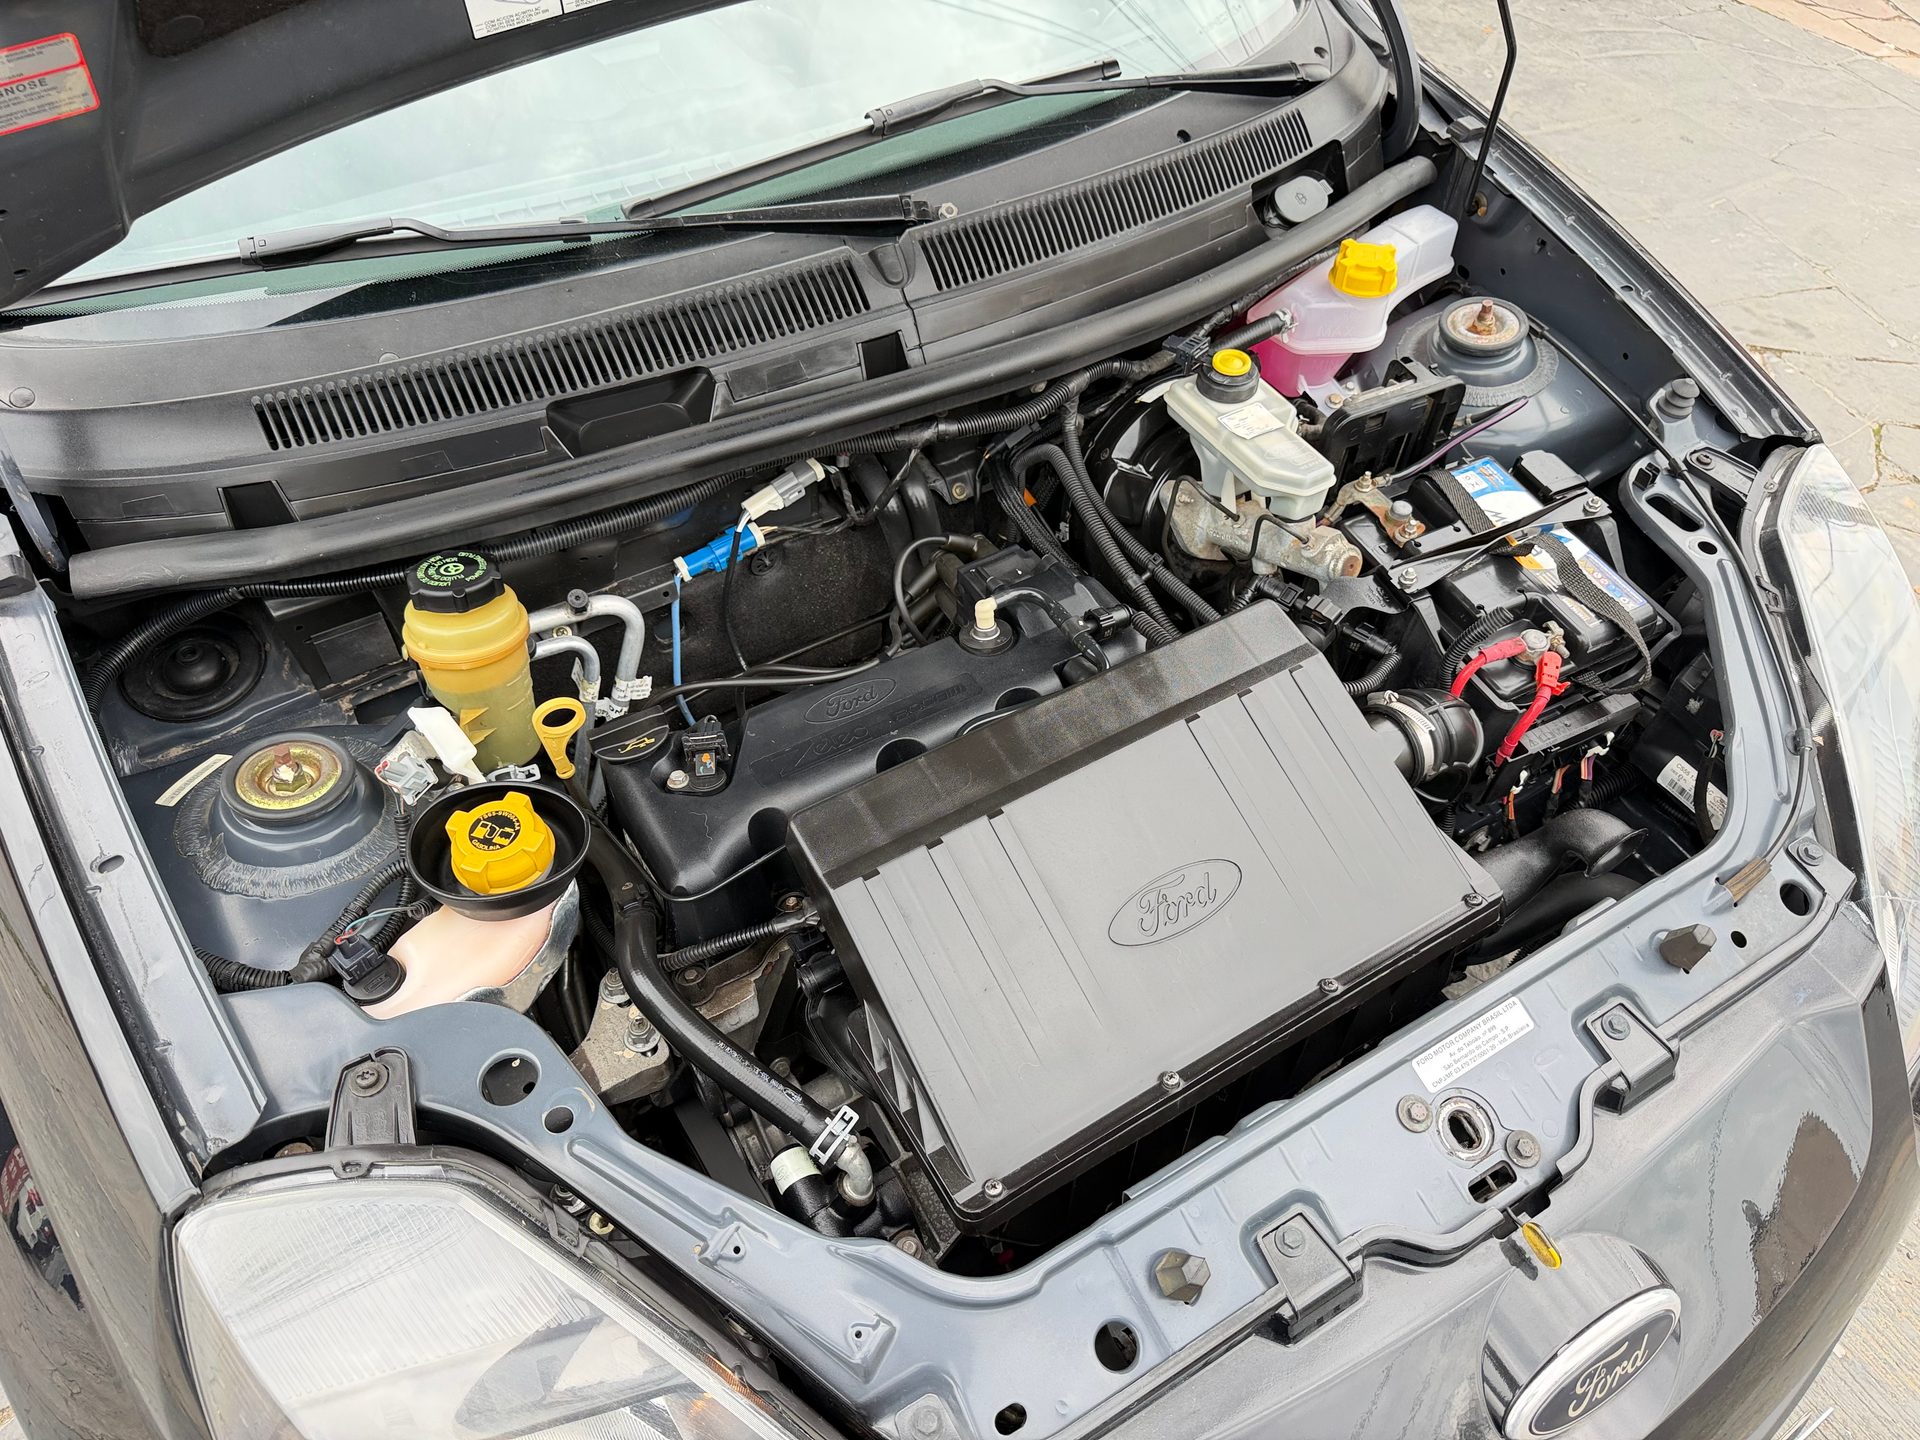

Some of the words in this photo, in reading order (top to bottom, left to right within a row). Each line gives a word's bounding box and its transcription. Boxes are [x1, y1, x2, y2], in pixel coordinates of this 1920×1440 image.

[825, 685, 880, 718] Ford
[472, 839, 501, 850] GASOLINA
[1137, 871, 1217, 937] Ford
[1415, 1052, 1434, 1067] FORD
[1432, 1039, 1455, 1057] MOTOR
[1453, 1022, 1482, 1042] COMPANY
[1481, 1009, 1503, 1026] BRASIL
[1501, 1000, 1518, 1013] LTDA
[1567, 1332, 1650, 1418] Ford
